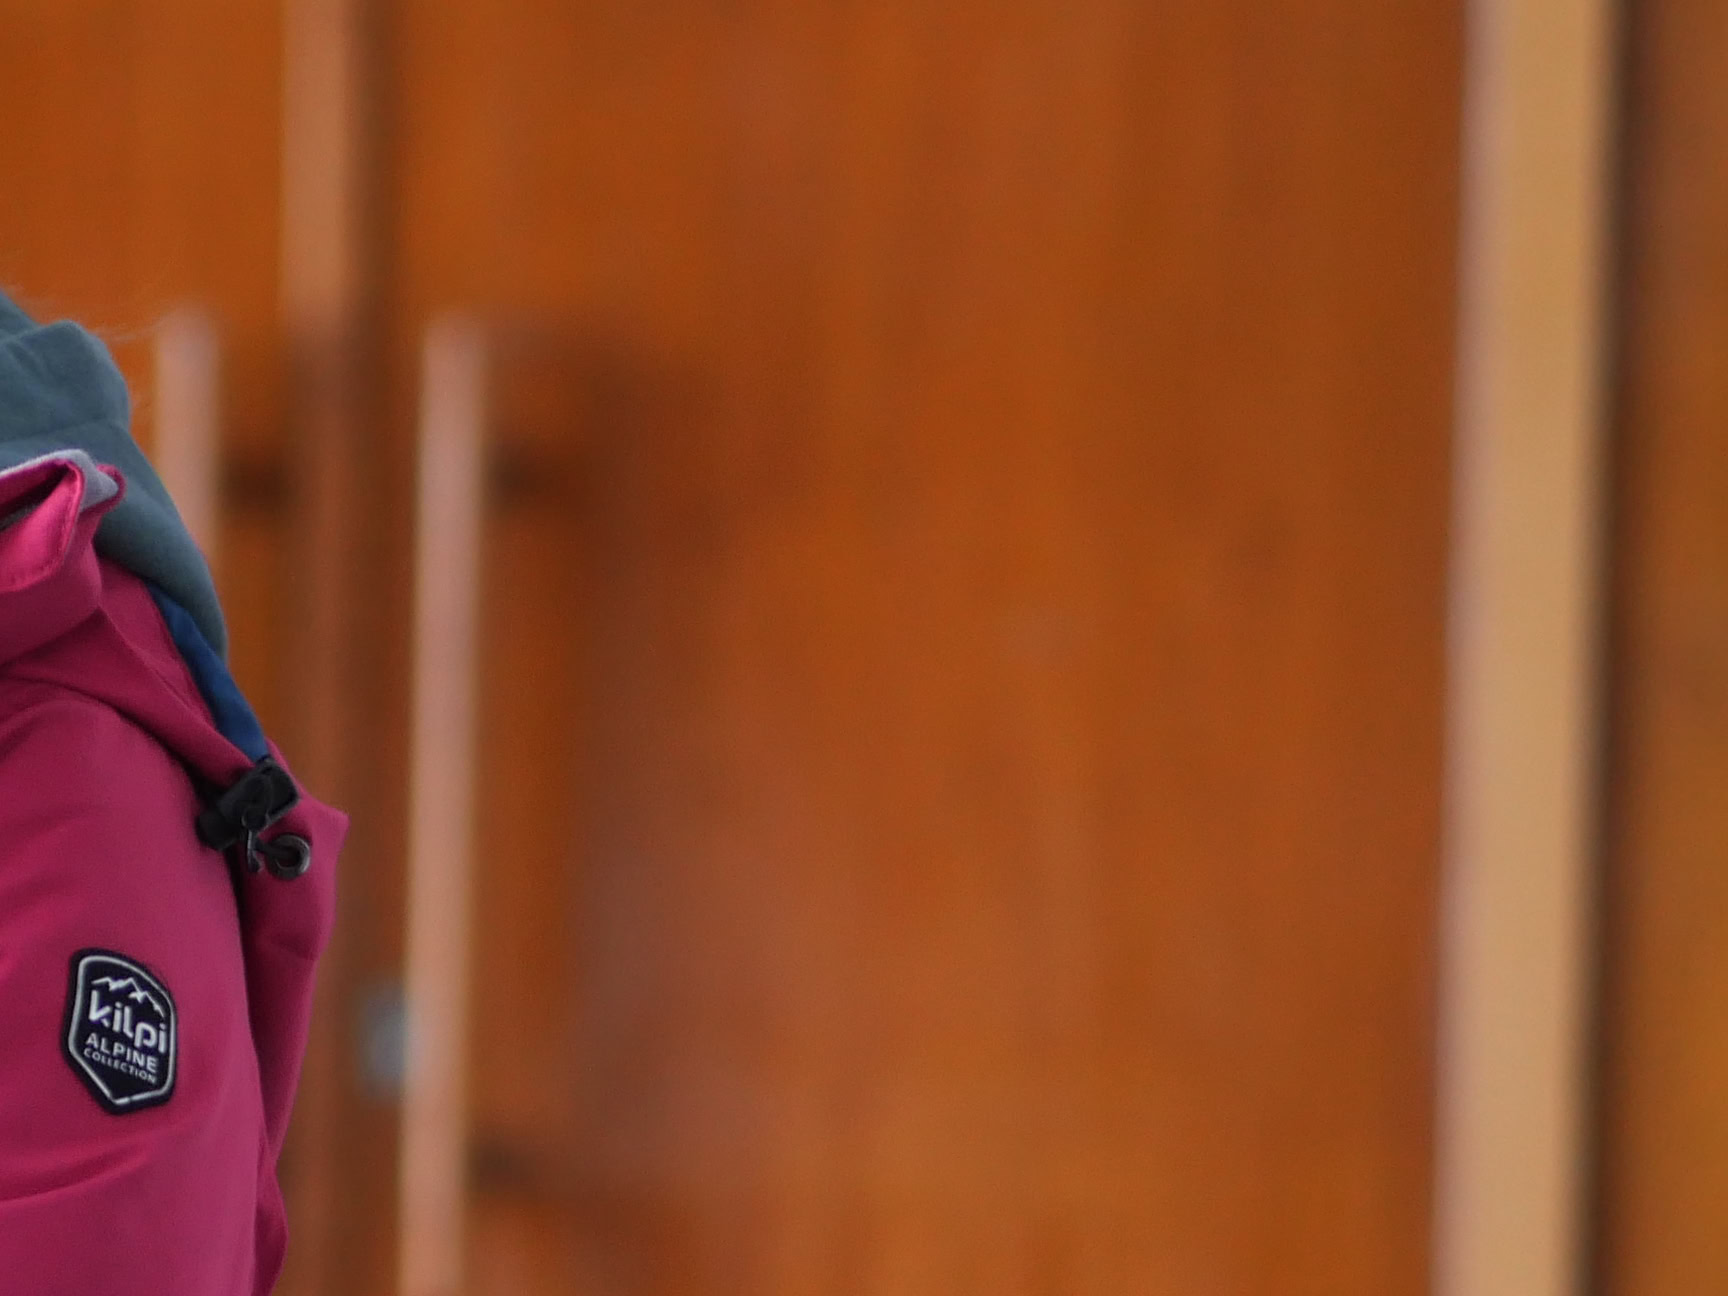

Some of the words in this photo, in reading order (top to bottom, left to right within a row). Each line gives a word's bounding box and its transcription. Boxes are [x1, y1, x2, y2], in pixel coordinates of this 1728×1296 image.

[89, 989, 167, 1054] kilpi
[84, 1047, 157, 1084] COLLECTION
[86, 1032, 158, 1074] ALPINE
